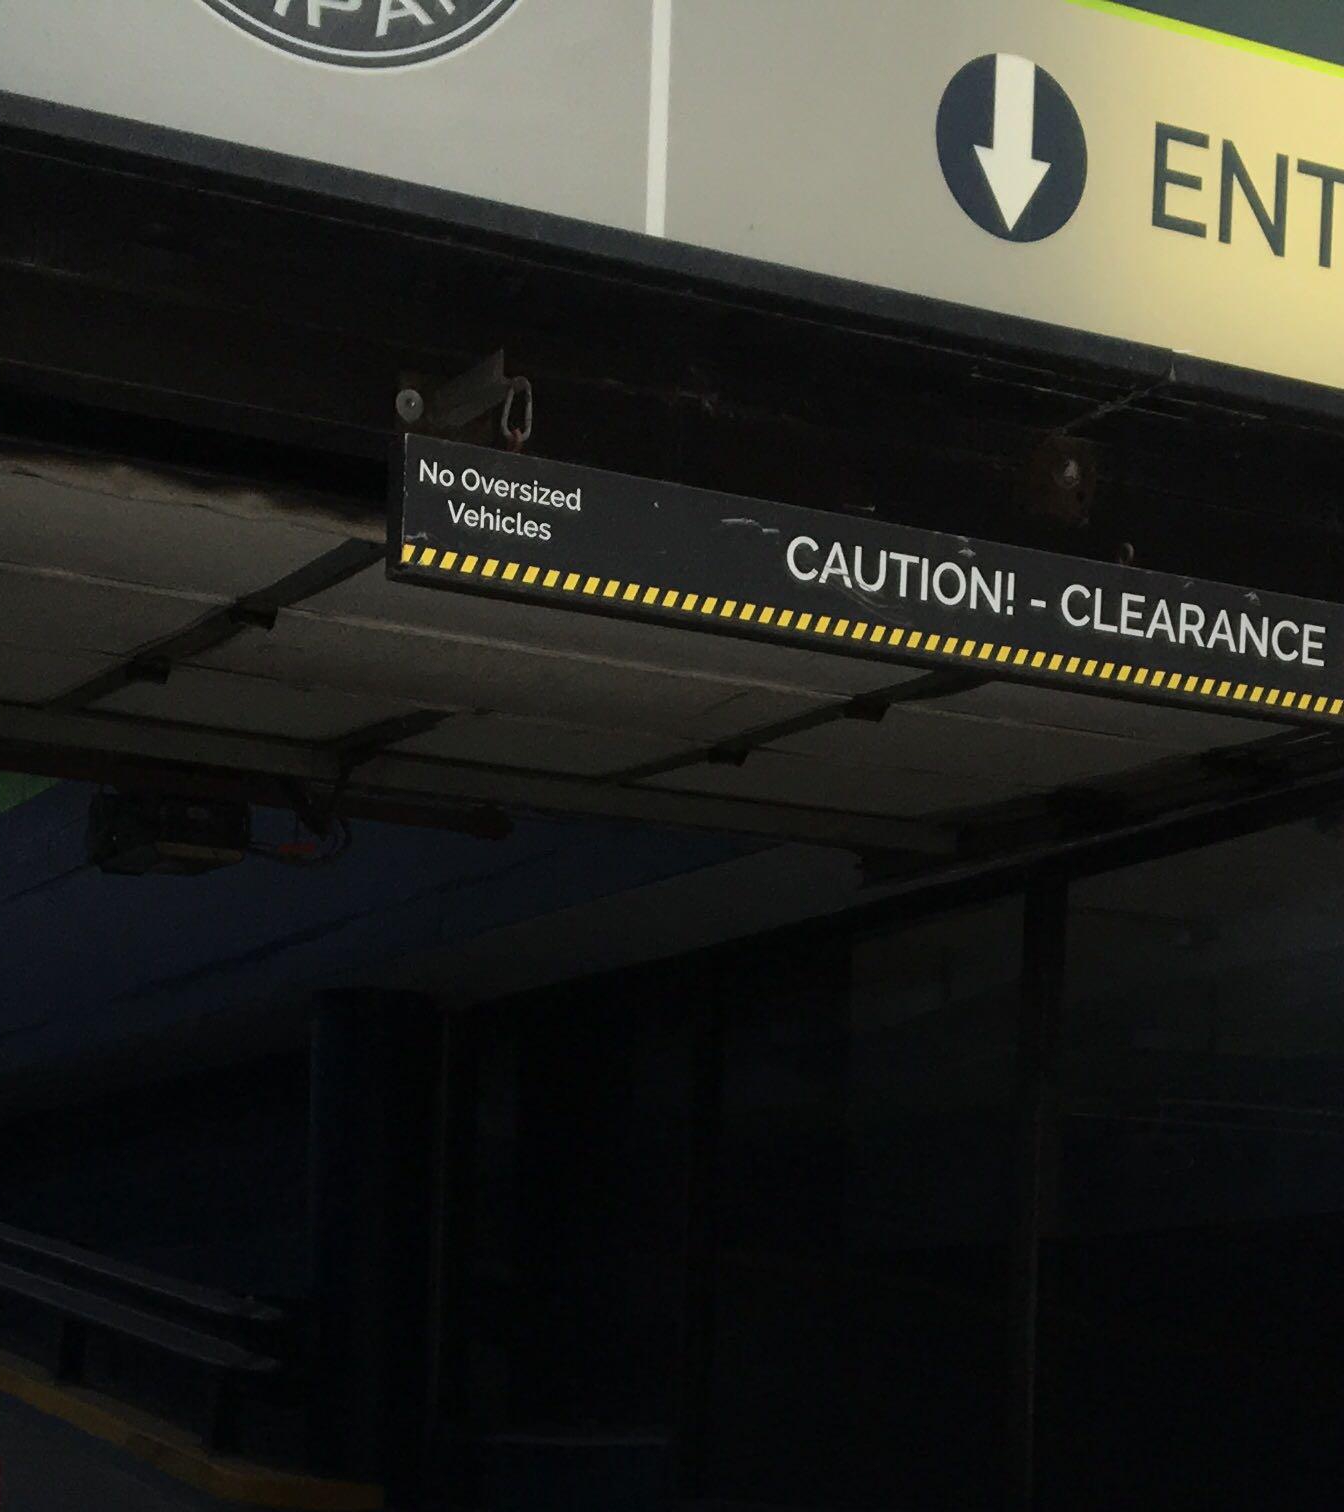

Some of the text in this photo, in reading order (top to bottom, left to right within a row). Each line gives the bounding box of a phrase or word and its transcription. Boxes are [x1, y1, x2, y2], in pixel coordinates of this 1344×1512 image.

[418, 458, 583, 512] No Oversized
[447, 500, 553, 541] Vehicles
[786, 535, 1016, 616] CAUTION!
[1029, 598, 1047, 608] -
[1060, 582, 1326, 668] CLEARANCE
